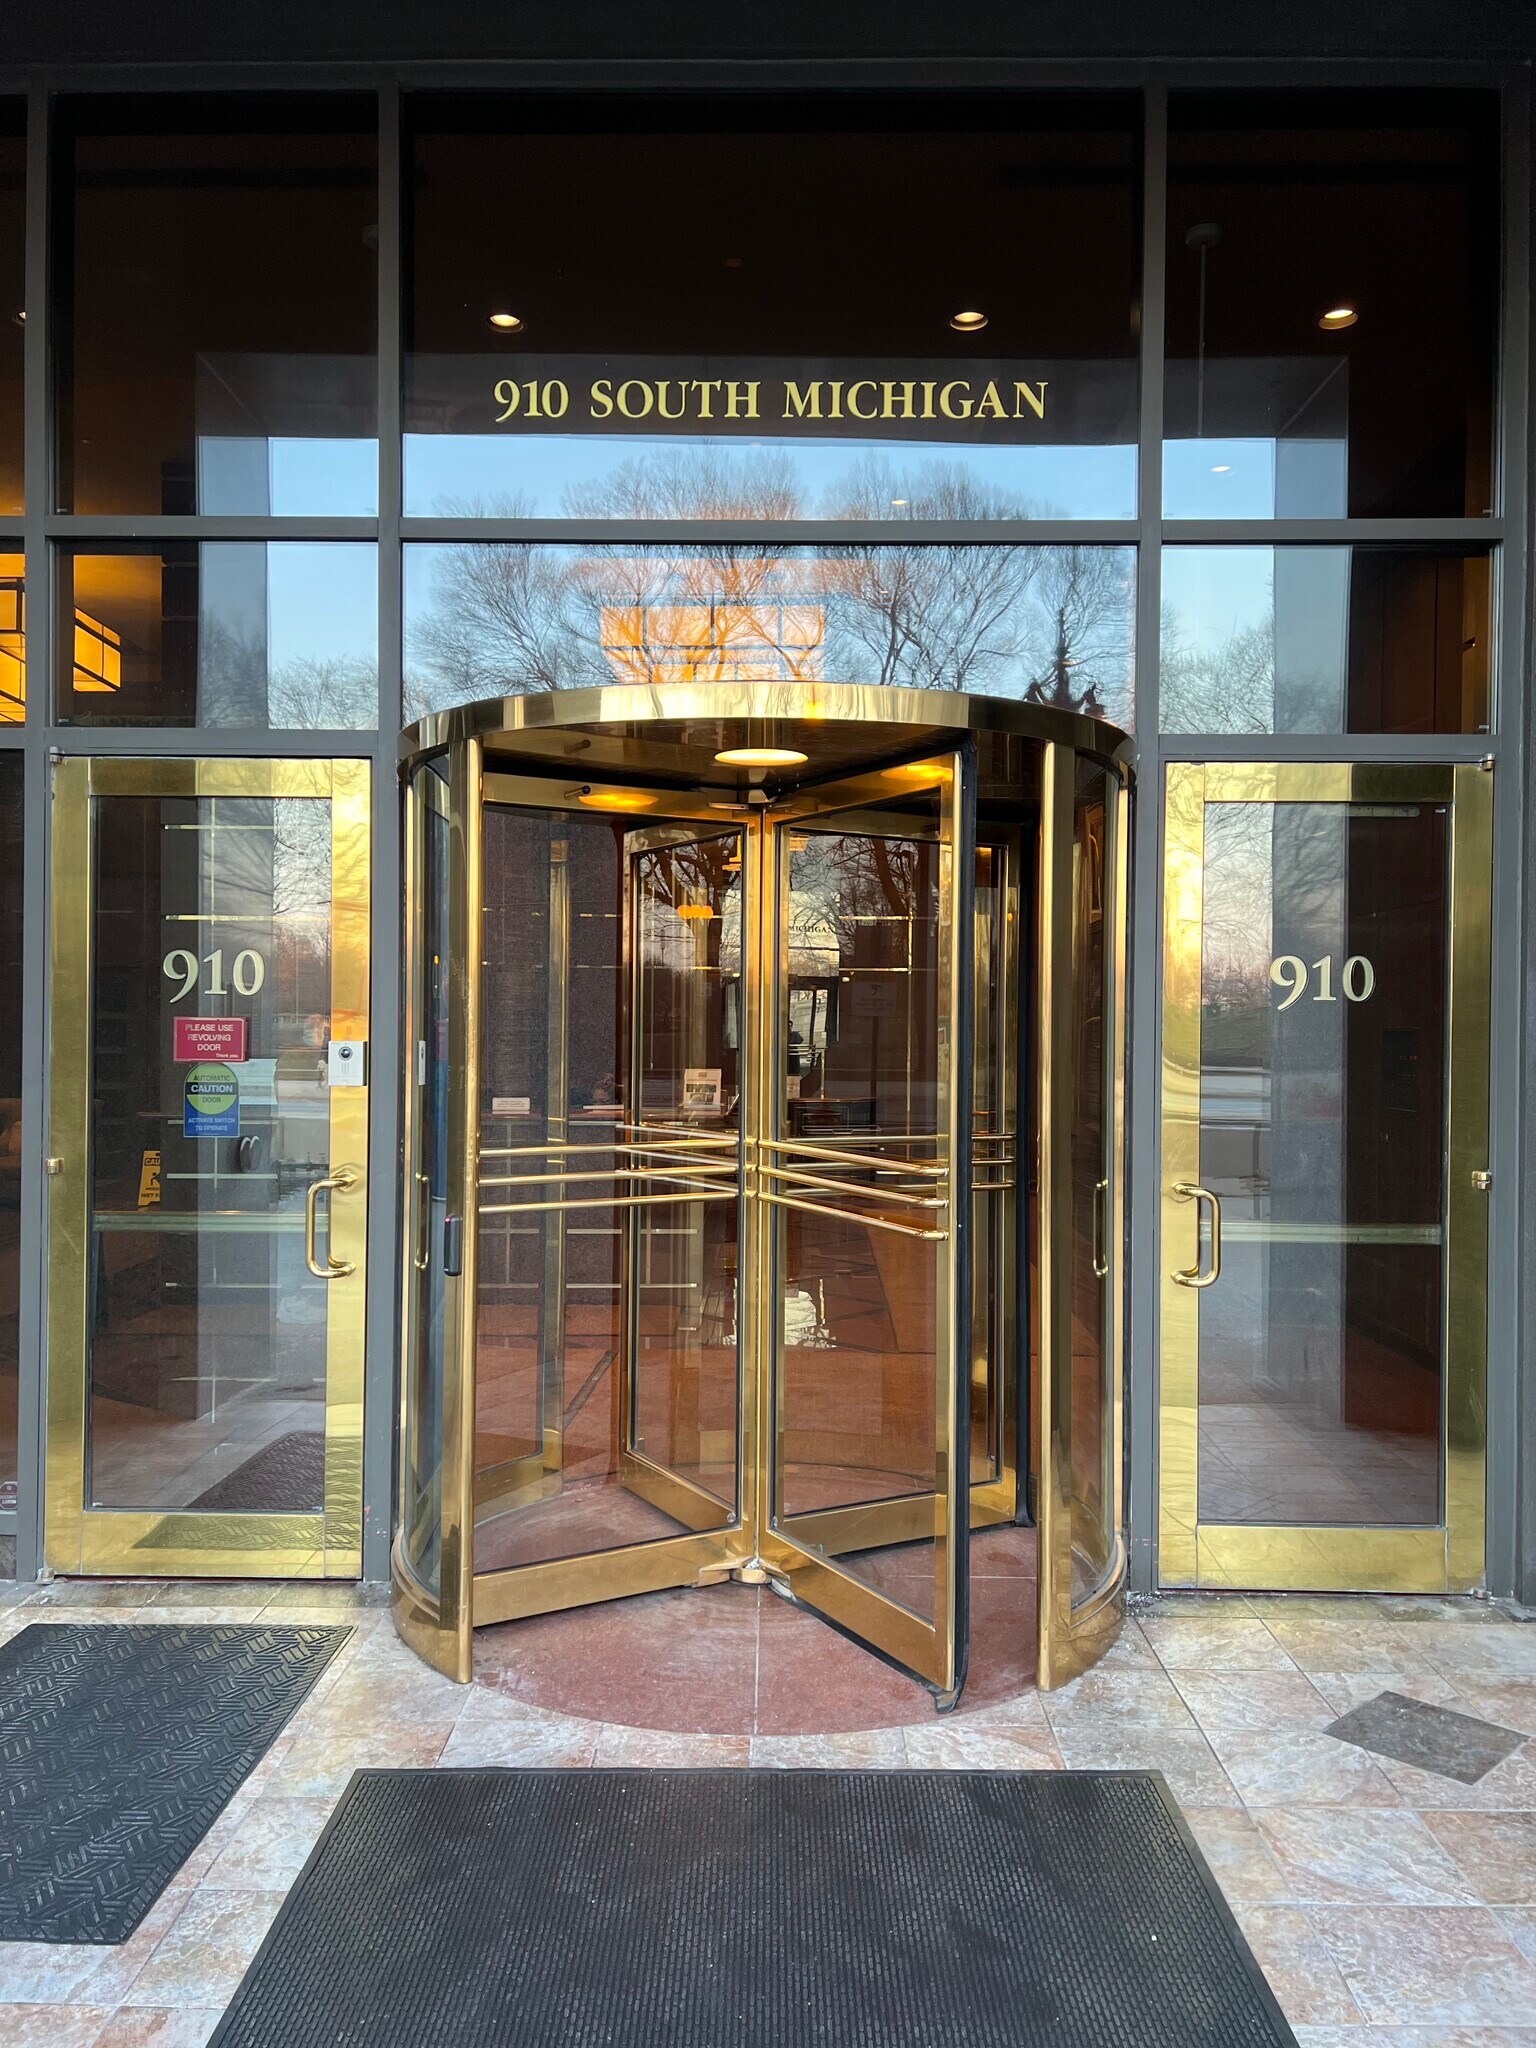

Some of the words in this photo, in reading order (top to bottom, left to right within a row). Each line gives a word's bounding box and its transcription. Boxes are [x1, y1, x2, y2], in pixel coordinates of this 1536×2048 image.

[494, 379, 569, 423] 910
[590, 380, 761, 418] SOUTH
[782, 381, 1049, 419] MICHIGAN
[162, 949, 265, 1004] 910
[1269, 954, 1375, 1011] 910
[197, 1043, 221, 1051] DOOR
[190, 1084, 233, 1093] CAUTION
